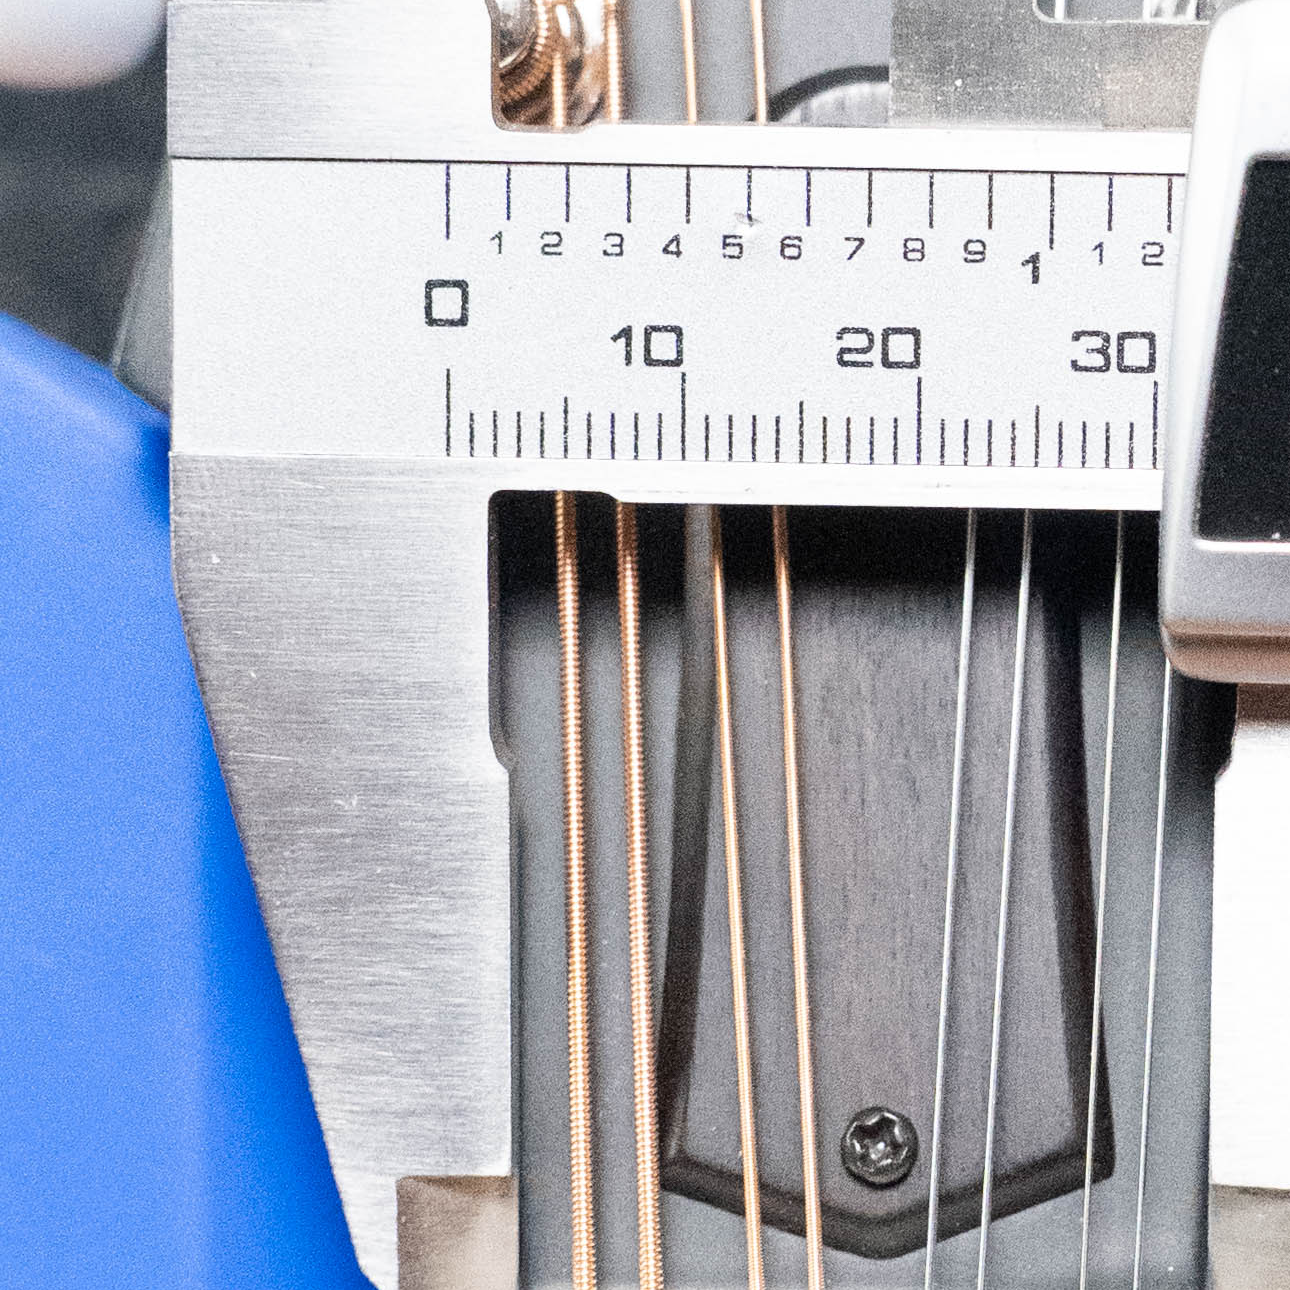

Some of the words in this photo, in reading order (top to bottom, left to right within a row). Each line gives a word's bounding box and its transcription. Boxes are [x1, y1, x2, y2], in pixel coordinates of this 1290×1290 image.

[490, 231, 503, 255] 1
[540, 231, 563, 255] 2
[602, 233, 624, 257] 3
[662, 234, 682, 257] 4
[722, 234, 744, 259] 5
[780, 235, 803, 260] 6
[844, 237, 865, 260] 7
[903, 237, 925, 261] 8
[963, 239, 986, 263] 9
[1021, 252, 1040, 284] 1
[1091, 241, 1104, 265] 1
[1141, 241, 1165, 266] 2
[424, 279, 469, 327] 0
[610, 325, 683, 367] 10
[836, 327, 921, 369] 20
[1071, 330, 1156, 374] 30
